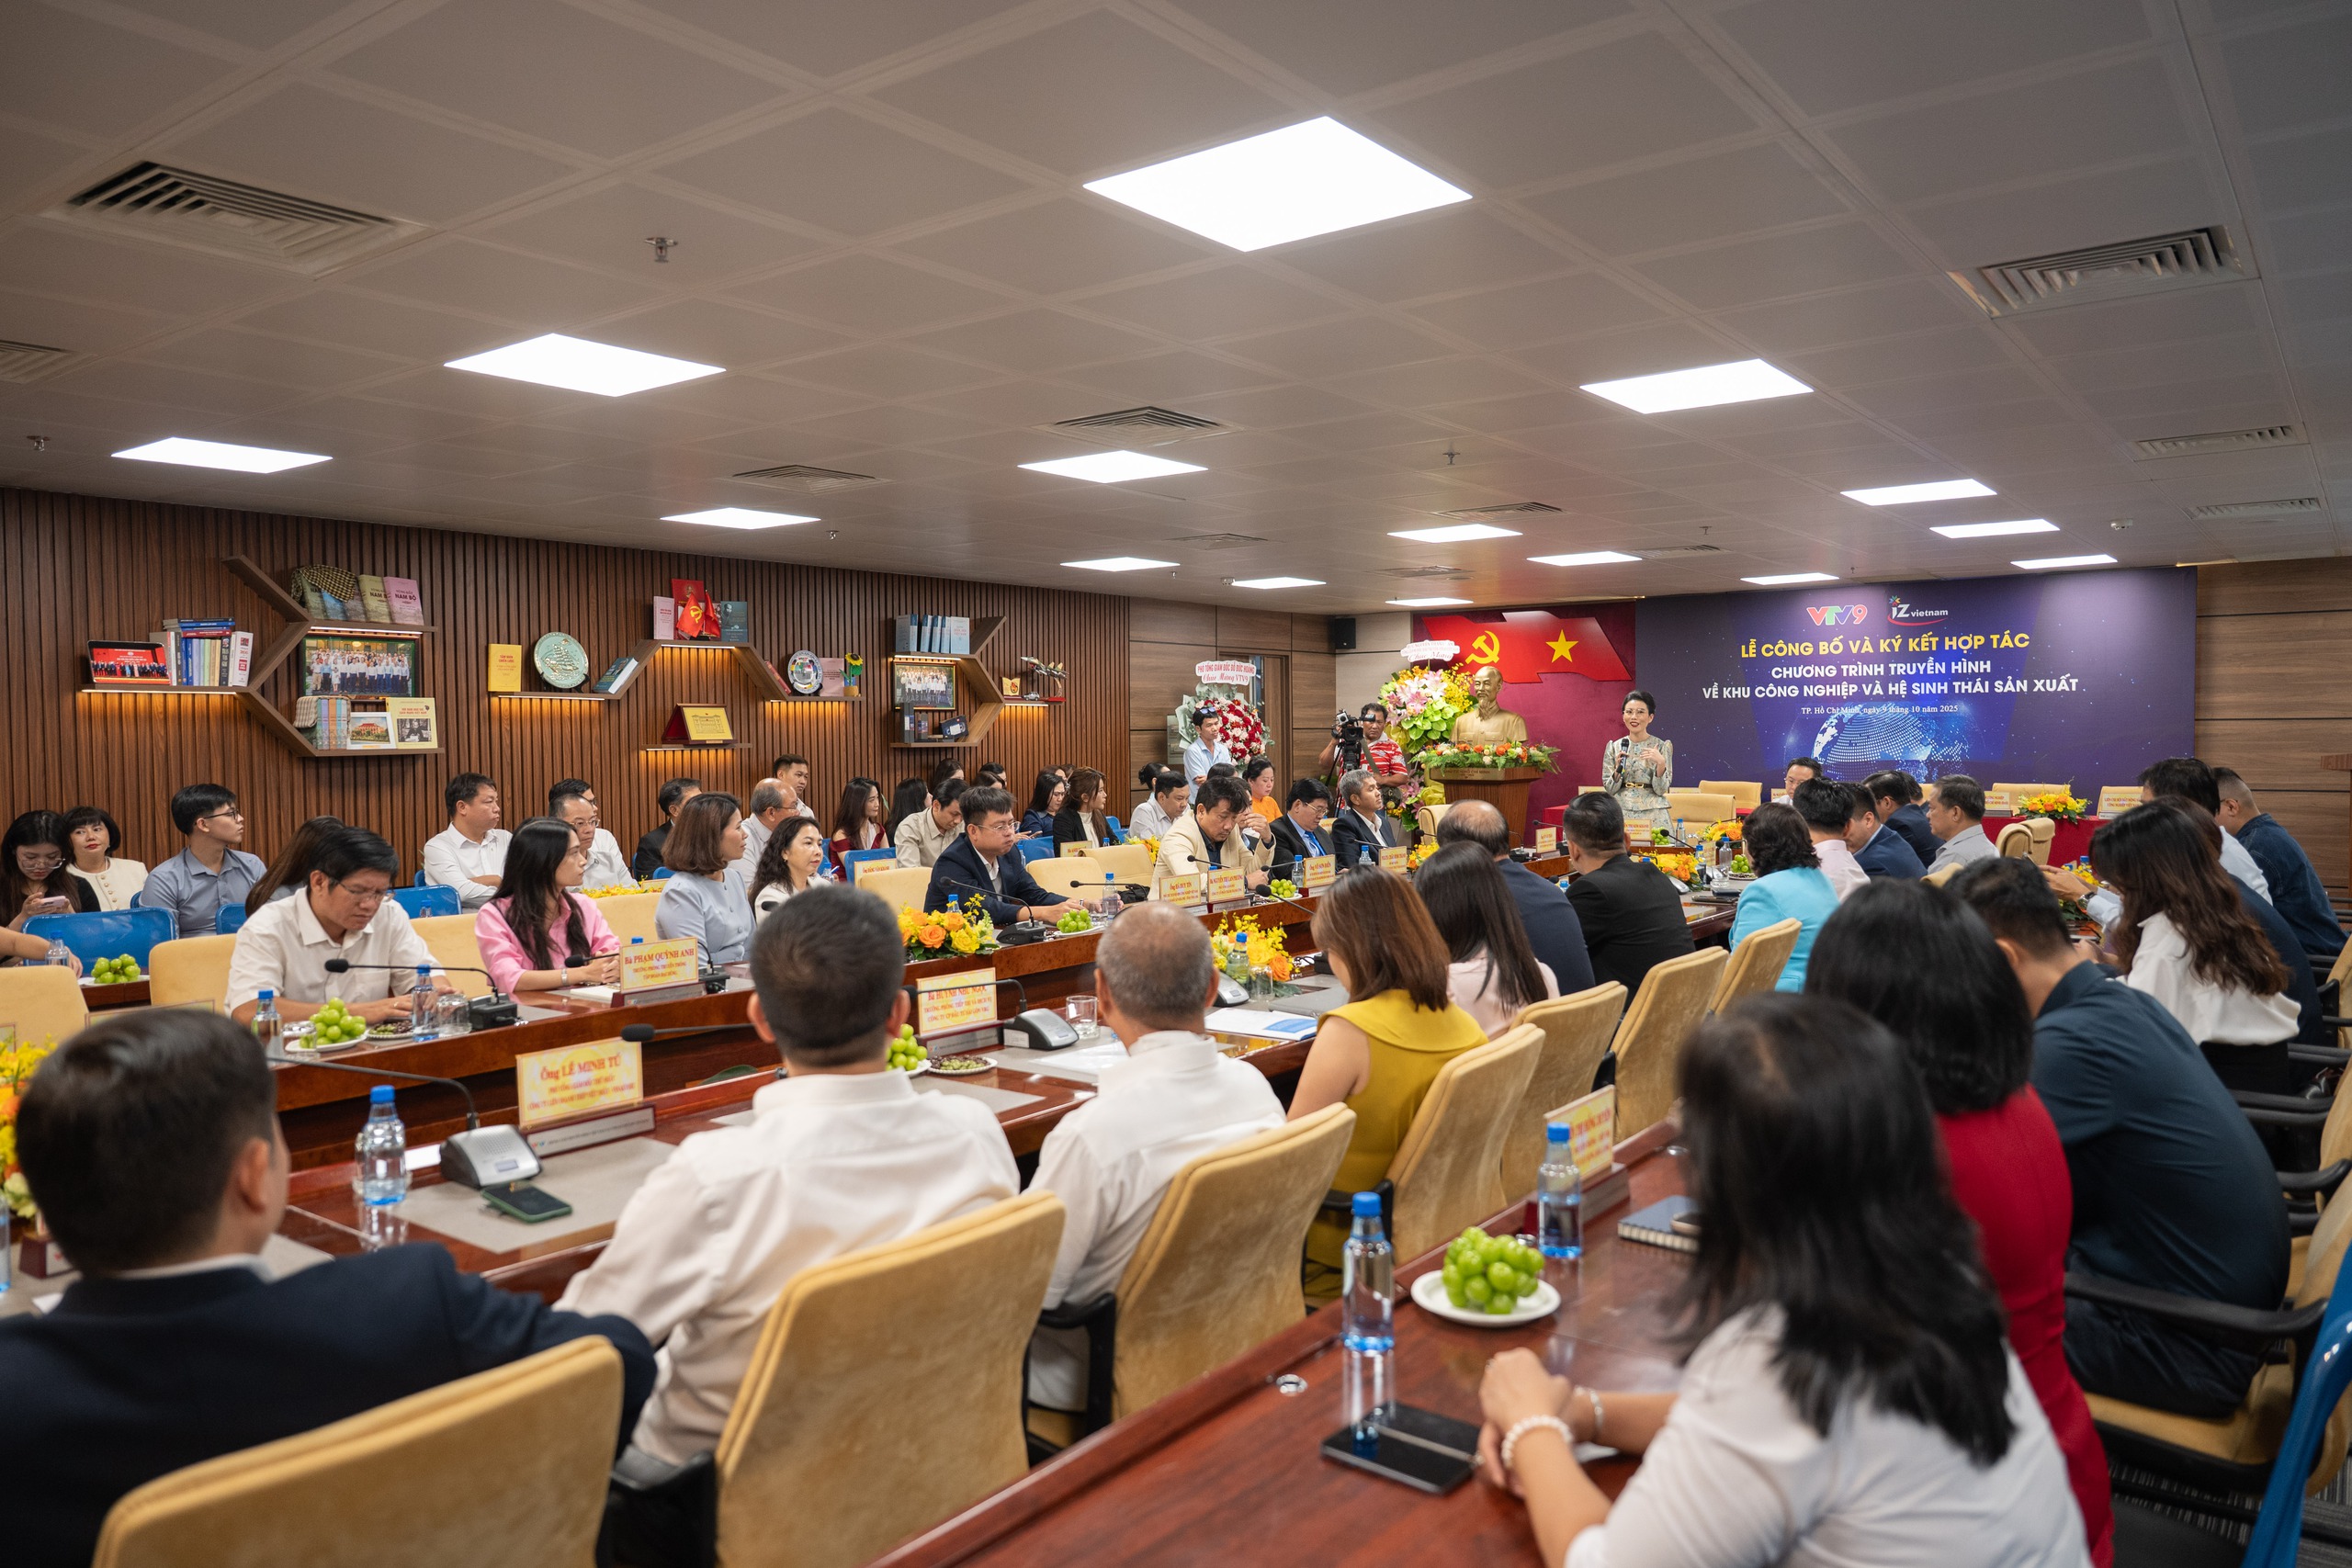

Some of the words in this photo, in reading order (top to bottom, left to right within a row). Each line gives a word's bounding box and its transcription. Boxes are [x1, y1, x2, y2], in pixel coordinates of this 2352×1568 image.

[1806, 604, 1868, 626] VTV9
[1911, 609, 1949, 617] vietnam
[1741, 638, 1757, 658] LỄ
[1761, 640, 1814, 657] CÔNG
[1819, 635, 1844, 655] BỐ
[1849, 636, 1873, 654] VÀ
[1880, 635, 1903, 652] KÝ
[1908, 631, 1939, 651] KẾT
[1944, 634, 1984, 653] HỢP
[1990, 629, 2030, 649] TÁC
[1771, 665, 1837, 679] CHƯƠNG
[1841, 661, 1884, 677] TRÌNH
[1889, 657, 1946, 675] TRUYỀN
[1951, 658, 1991, 673] HÌNH
[1702, 682, 1719, 699] VỀ
[1723, 686, 1750, 699] KHU
[1755, 683, 1799, 698] CÔNG
[1804, 682, 1858, 699] NGHIỆP
[1862, 681, 1883, 695] VÀ
[1888, 680, 1907, 698] HỆ
[1911, 682, 1948, 694] SINH
[1952, 677, 1989, 694] THÁI
[1994, 676, 2028, 693] SẢN
[2033, 673, 2078, 692] XUẤT
[1815, 705, 1825, 714] Hồ
[1863, 706, 1880, 716] ngày
[1889, 705, 1909, 715] tháng
[625, 956, 632, 964] Bà
[634, 953, 654, 964] PHẠM
[655, 949, 679, 962] QUỲNH
[681, 949, 695, 957] ANH
[540, 1066, 560, 1081] Ông
[562, 1060, 575, 1077] LÊ
[578, 1058, 605, 1073] MINH
